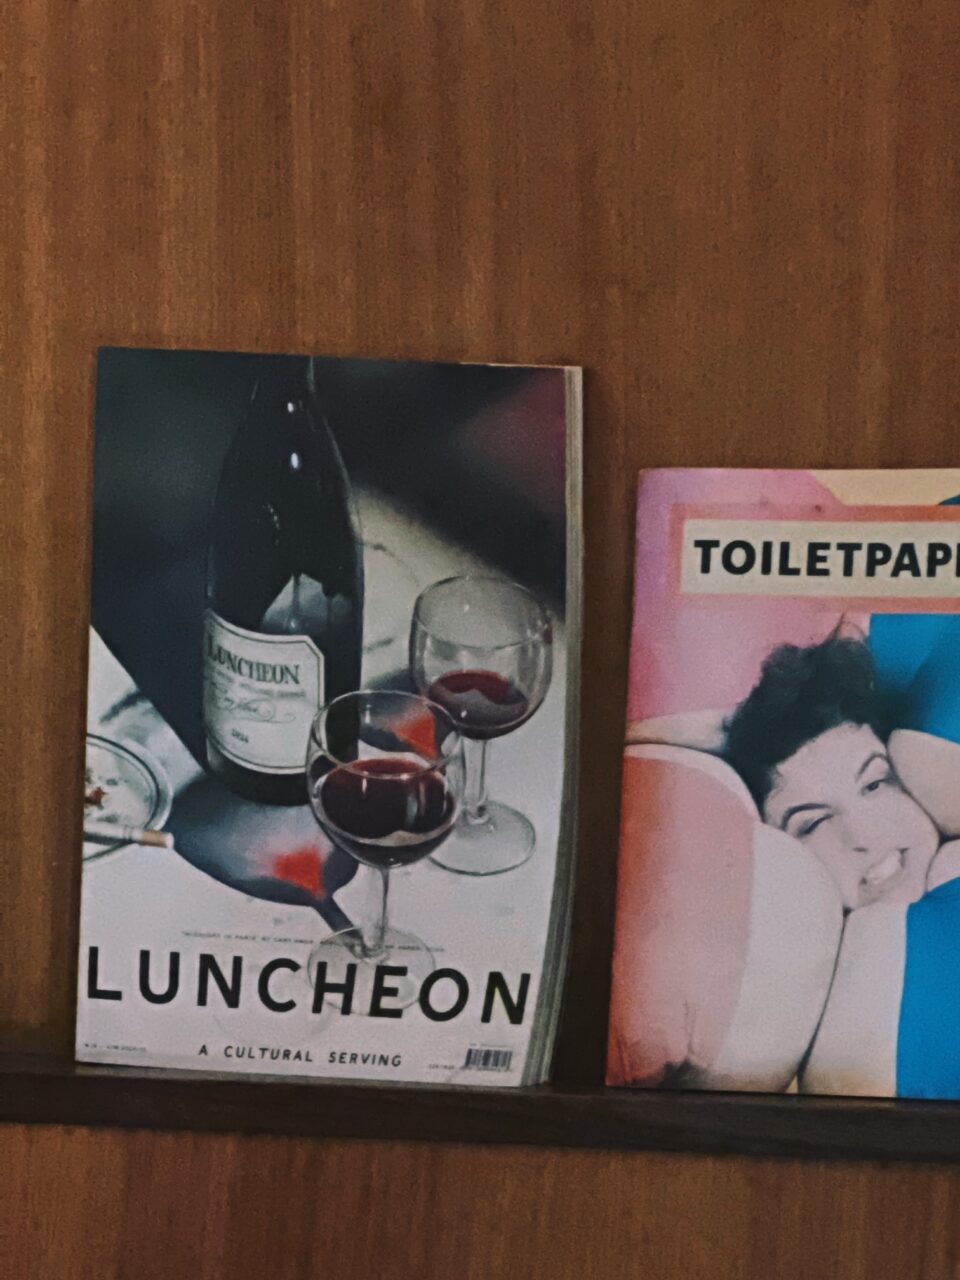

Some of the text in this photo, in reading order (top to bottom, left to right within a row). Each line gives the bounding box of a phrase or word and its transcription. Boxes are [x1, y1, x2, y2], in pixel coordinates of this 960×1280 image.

[207, 634, 300, 684] LUNCHEON
[87, 946, 531, 1025] LUNCHEON
[198, 1044, 401, 1067] A CULTURAL SERVING
